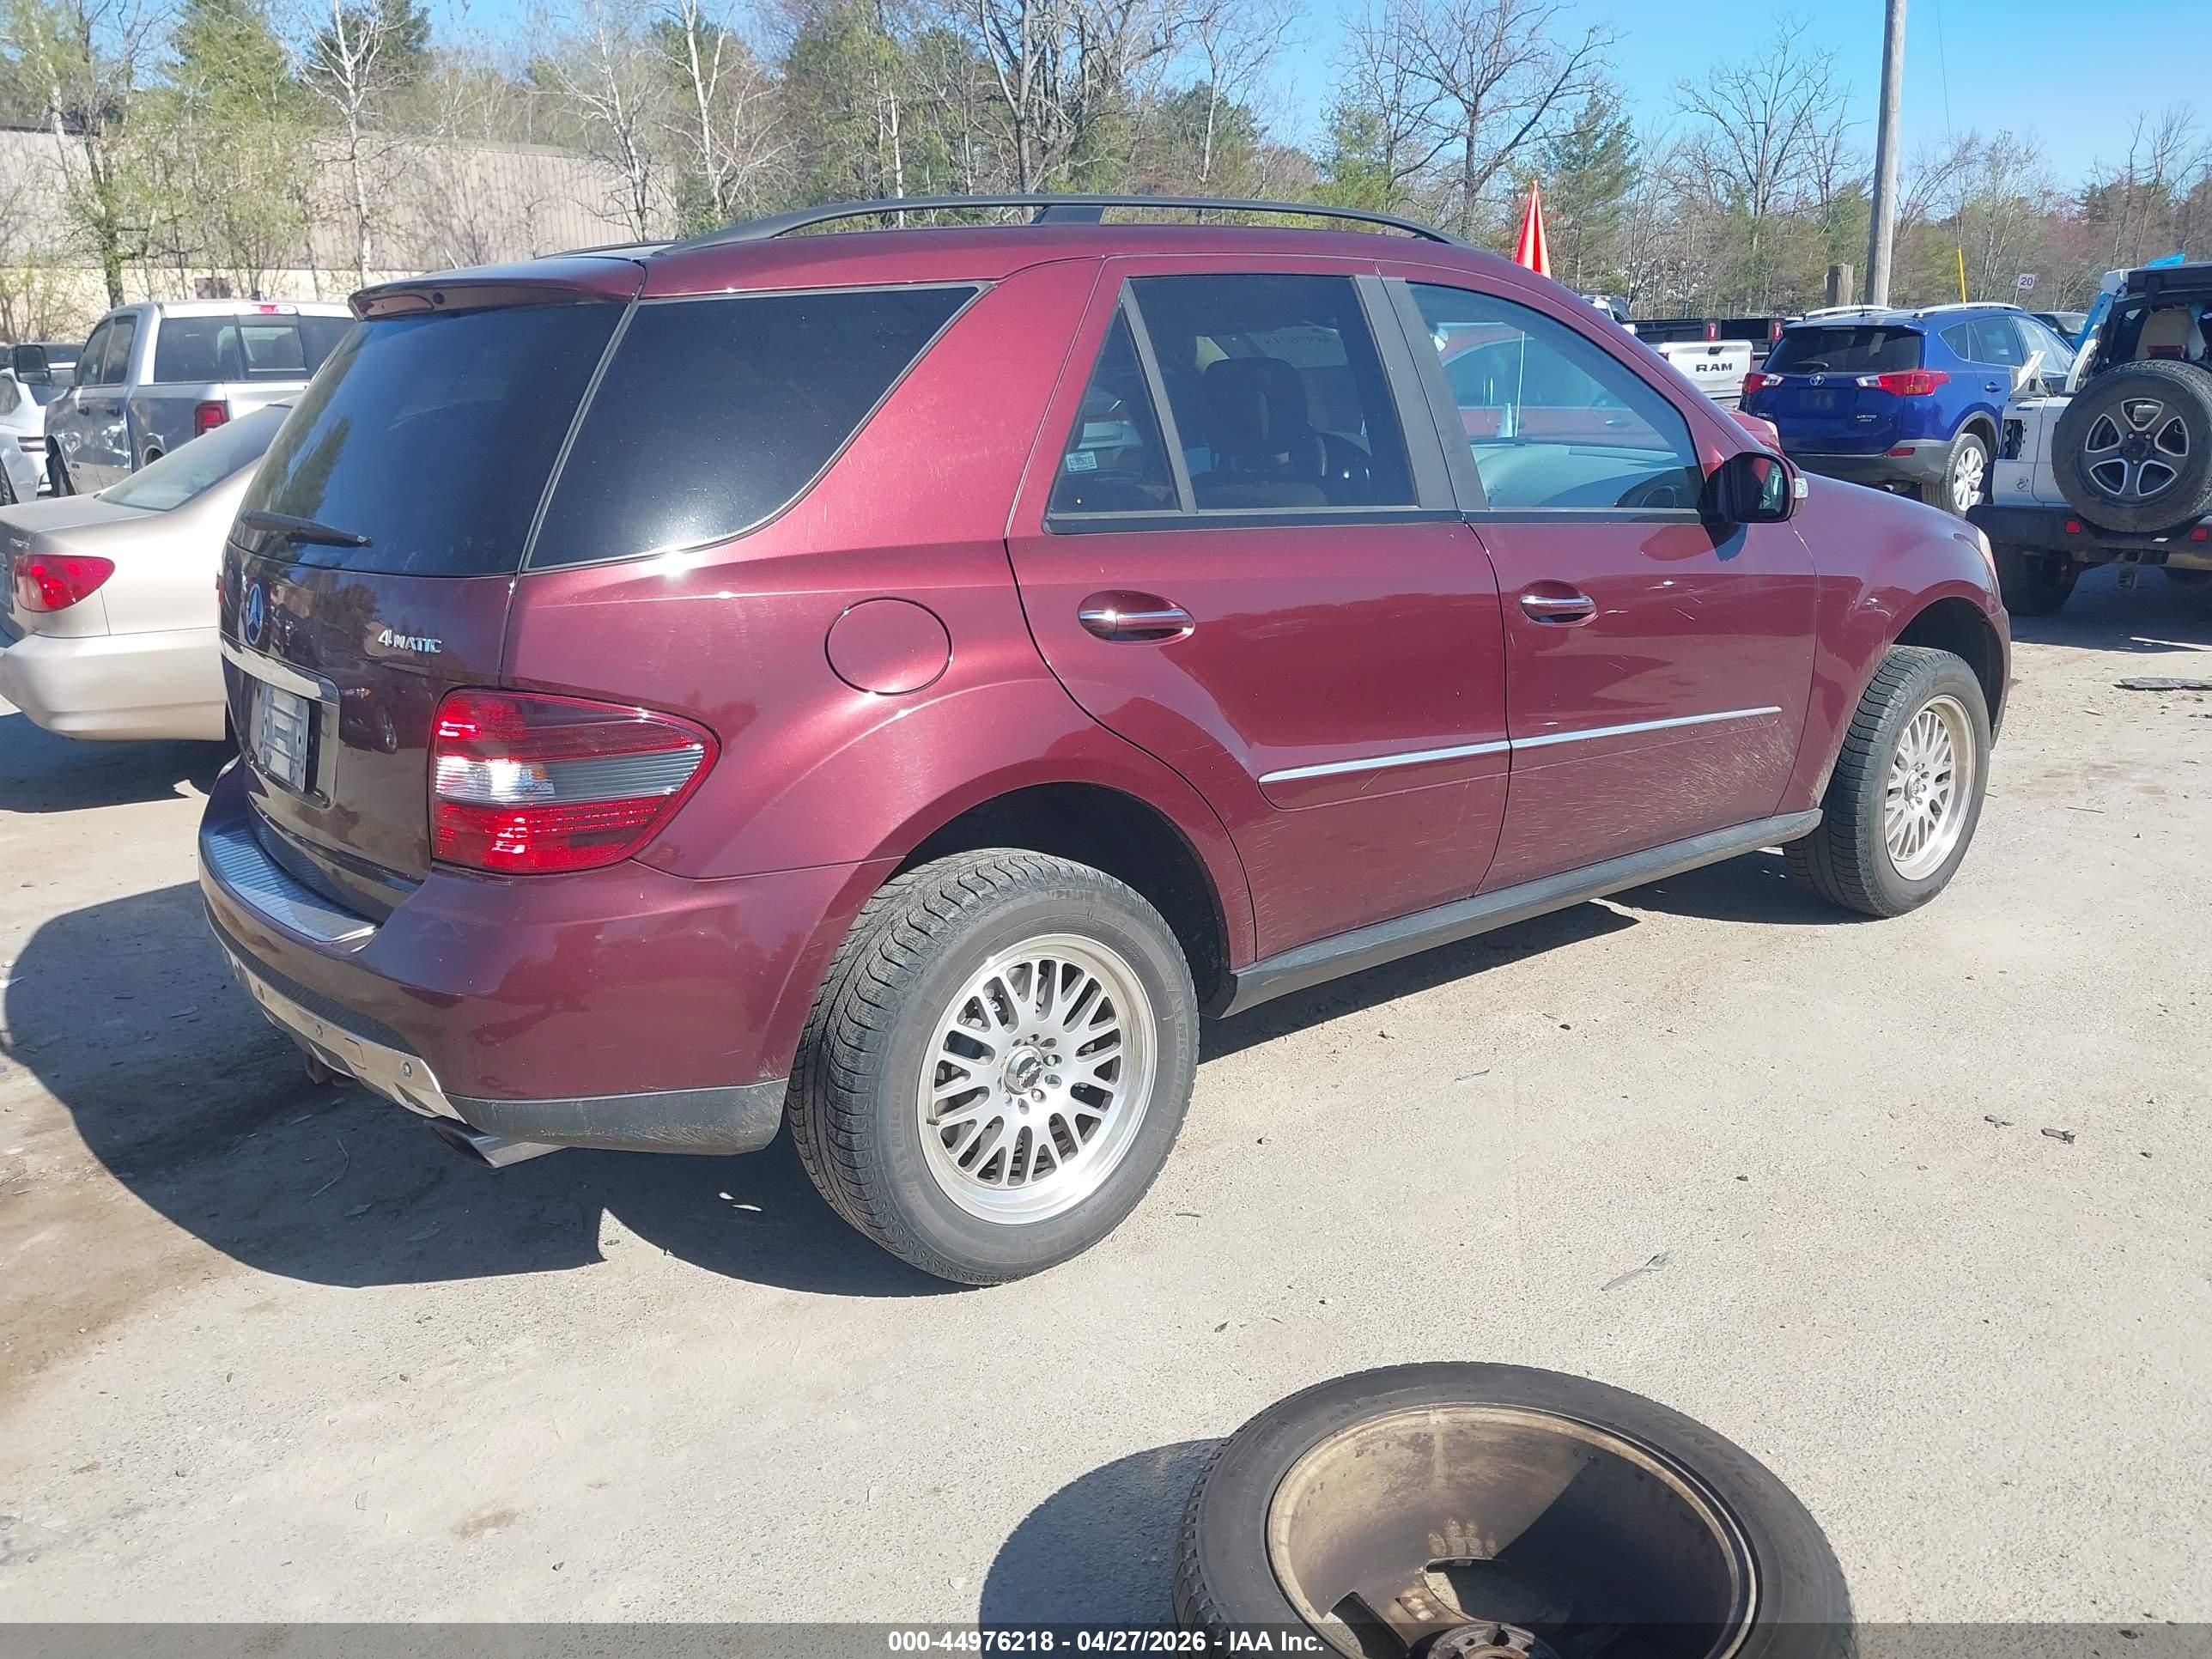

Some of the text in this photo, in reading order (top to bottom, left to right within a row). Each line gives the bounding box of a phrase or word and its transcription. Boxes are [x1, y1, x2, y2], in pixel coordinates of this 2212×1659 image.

[2020, 276, 2033, 286] 20
[1695, 362, 1733, 372] RAM
[378, 629, 442, 653] 4MATIC
